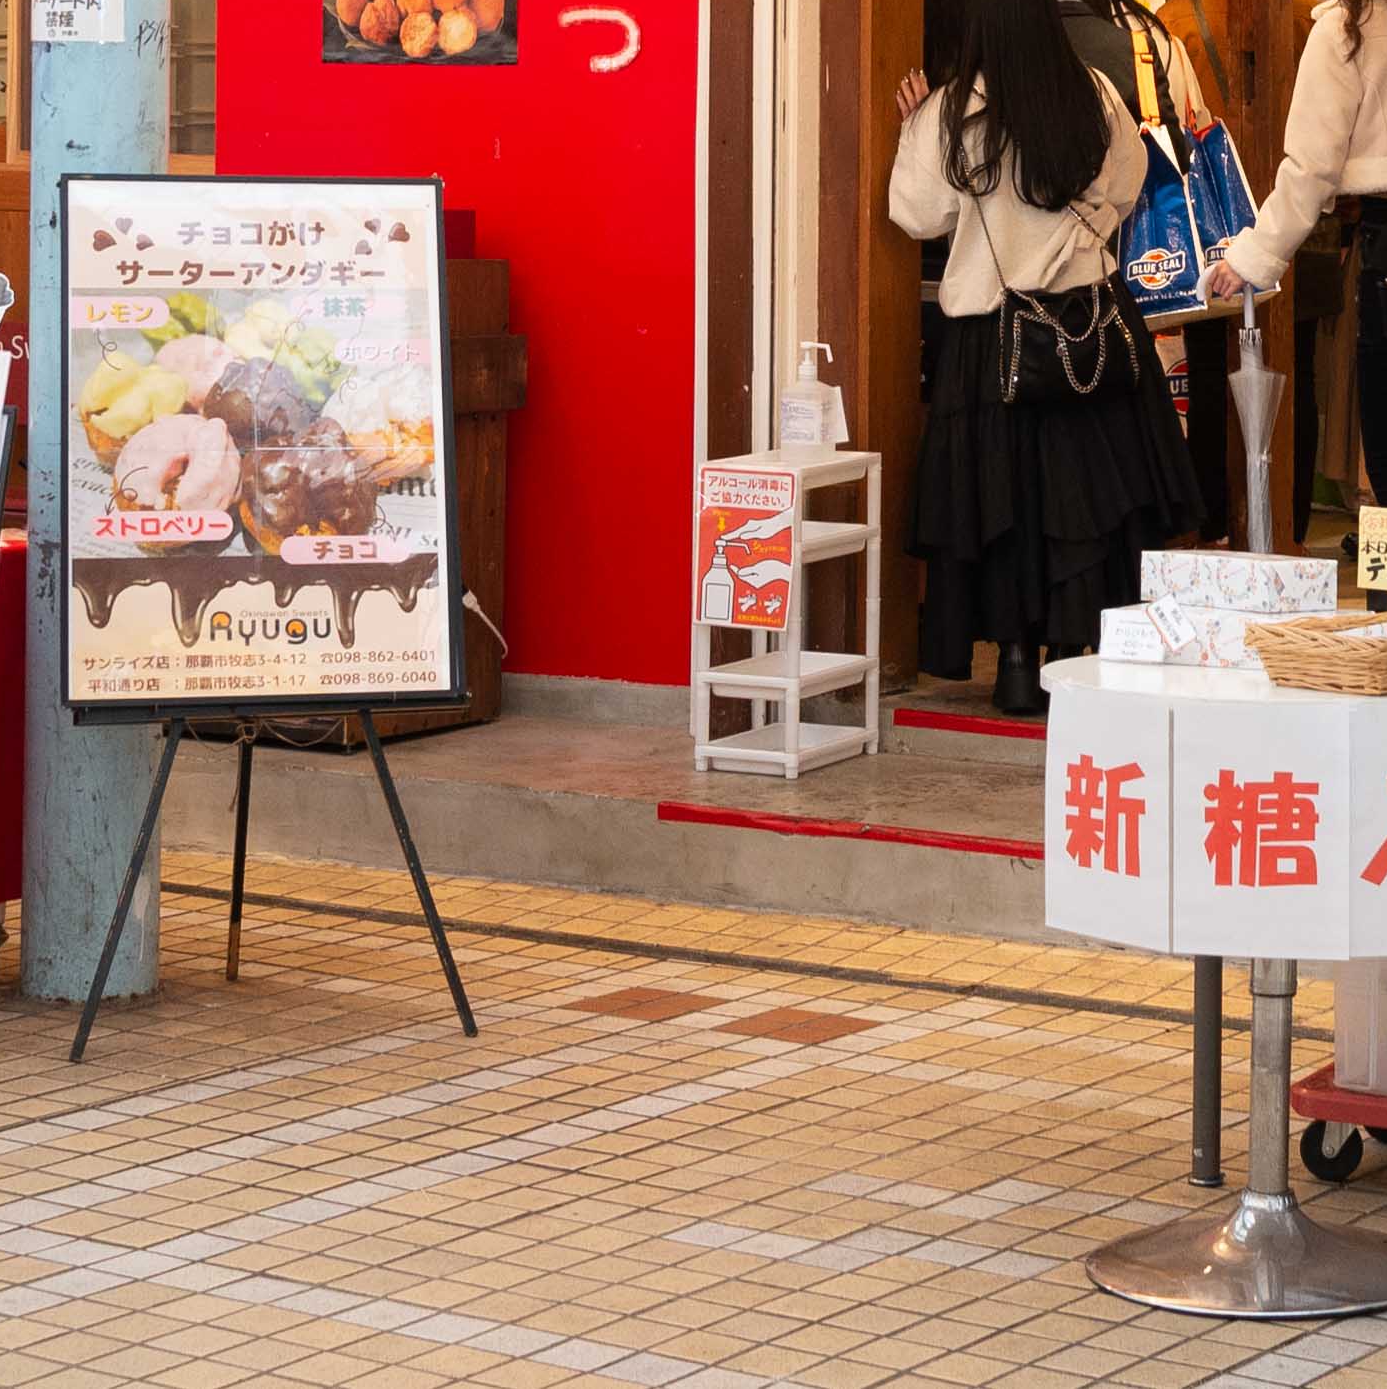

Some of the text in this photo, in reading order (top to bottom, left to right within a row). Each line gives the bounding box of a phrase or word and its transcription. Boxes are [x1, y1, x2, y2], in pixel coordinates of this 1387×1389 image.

[176, 221, 326, 247] チョコがけ
[116, 260, 386, 287] サーターアンダギー
[1132, 258, 1181, 275] BLUE SEAL
[86, 304, 155, 324] レモン
[323, 297, 366, 318] 抹茶
[340, 345, 421, 363] ホワイト
[708, 475, 790, 492] アルコール消毒に
[710, 491, 786, 508] ご協力ください。
[95, 515, 229, 537] ストロベリー
[313, 539, 378, 560] チョコ
[210, 611, 331, 647] Ryugu
[88, 677, 161, 693] 平和通り店
[331, 672, 437, 687] 098-869-6040
